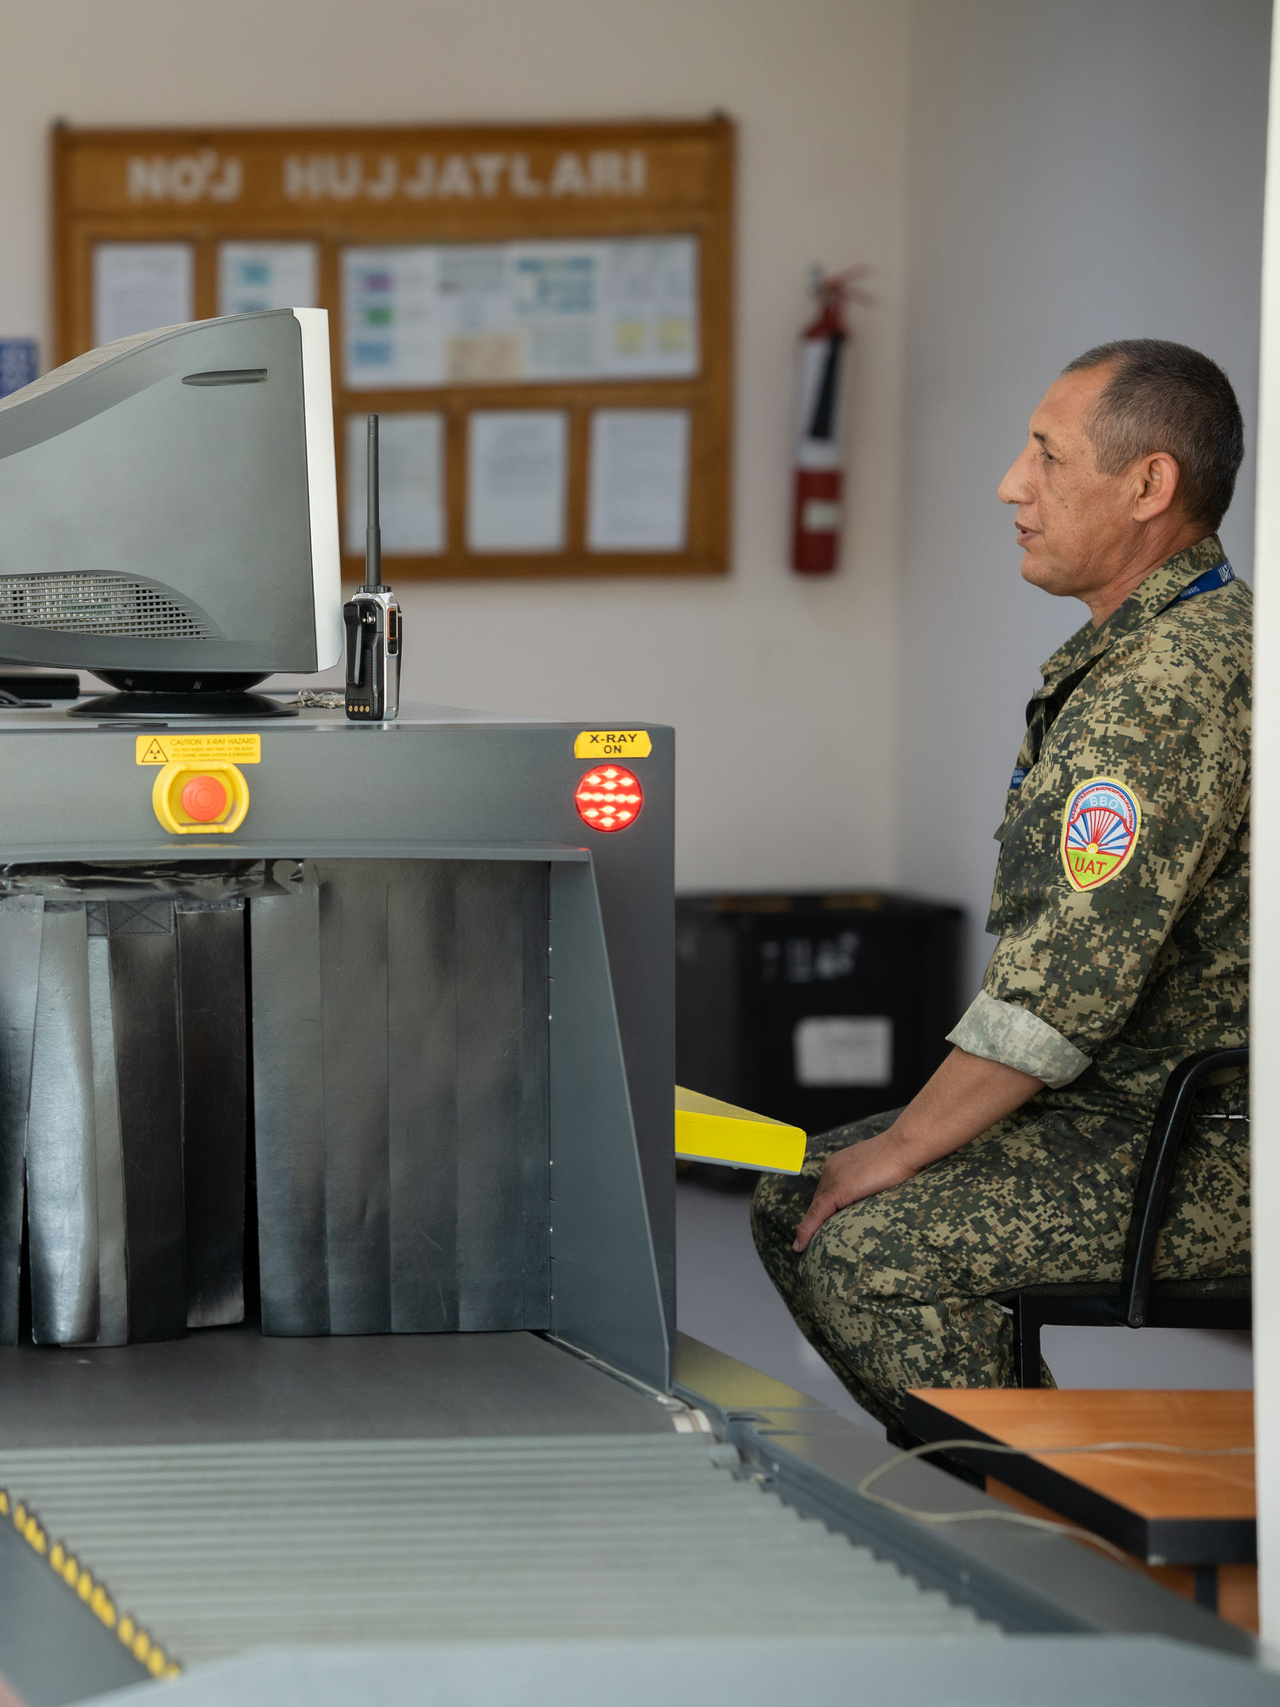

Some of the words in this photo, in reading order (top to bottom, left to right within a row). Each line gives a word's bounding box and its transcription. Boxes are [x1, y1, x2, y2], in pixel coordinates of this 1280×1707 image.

[282, 150, 647, 202] HUJJATLARI
[228, 737, 256, 745] HAZARD
[589, 733, 638, 743] X-RAY
[603, 745, 622, 754] ON
[1074, 857, 1108, 875] UAT
